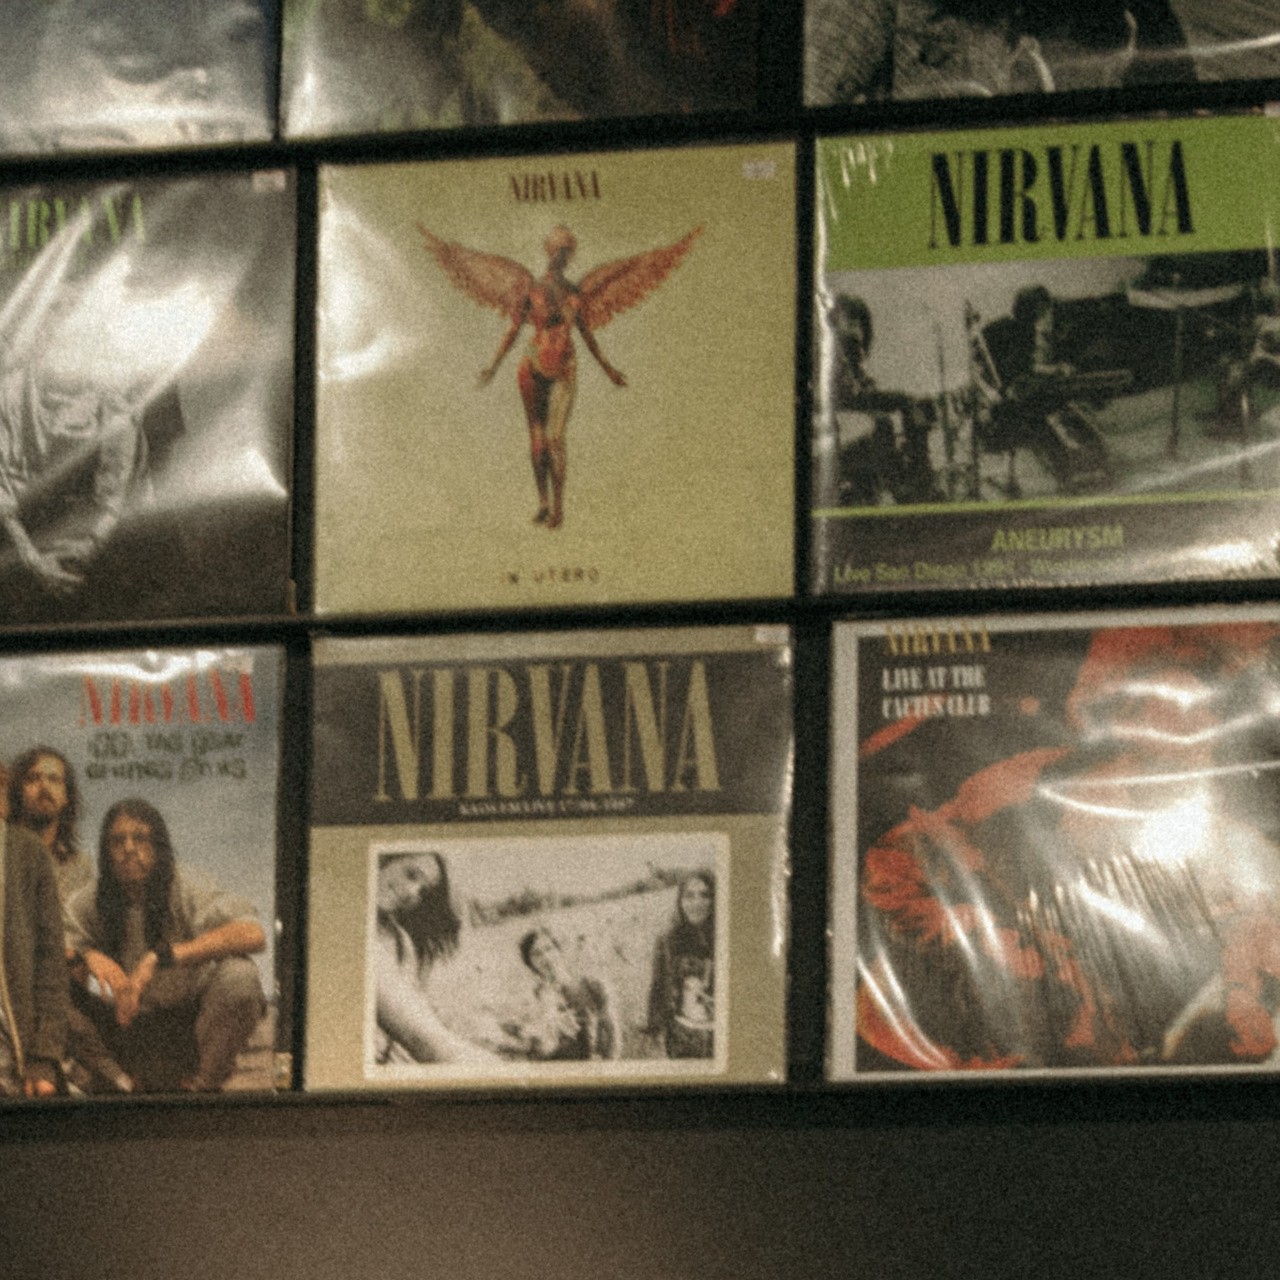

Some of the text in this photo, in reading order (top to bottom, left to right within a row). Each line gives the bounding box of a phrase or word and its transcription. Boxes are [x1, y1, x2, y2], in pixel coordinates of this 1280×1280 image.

[928, 139, 1196, 250] NIRVANA
[991, 525, 1123, 551] ANEURYSM
[833, 564, 871, 583] Live
[875, 562, 911, 581] San
[914, 560, 967, 582] Diego
[883, 621, 991, 656] NIRVANA
[882, 664, 986, 692] LIVE AT THE
[78, 667, 257, 726] NIRVANA
[376, 659, 721, 802] NIRVANA
